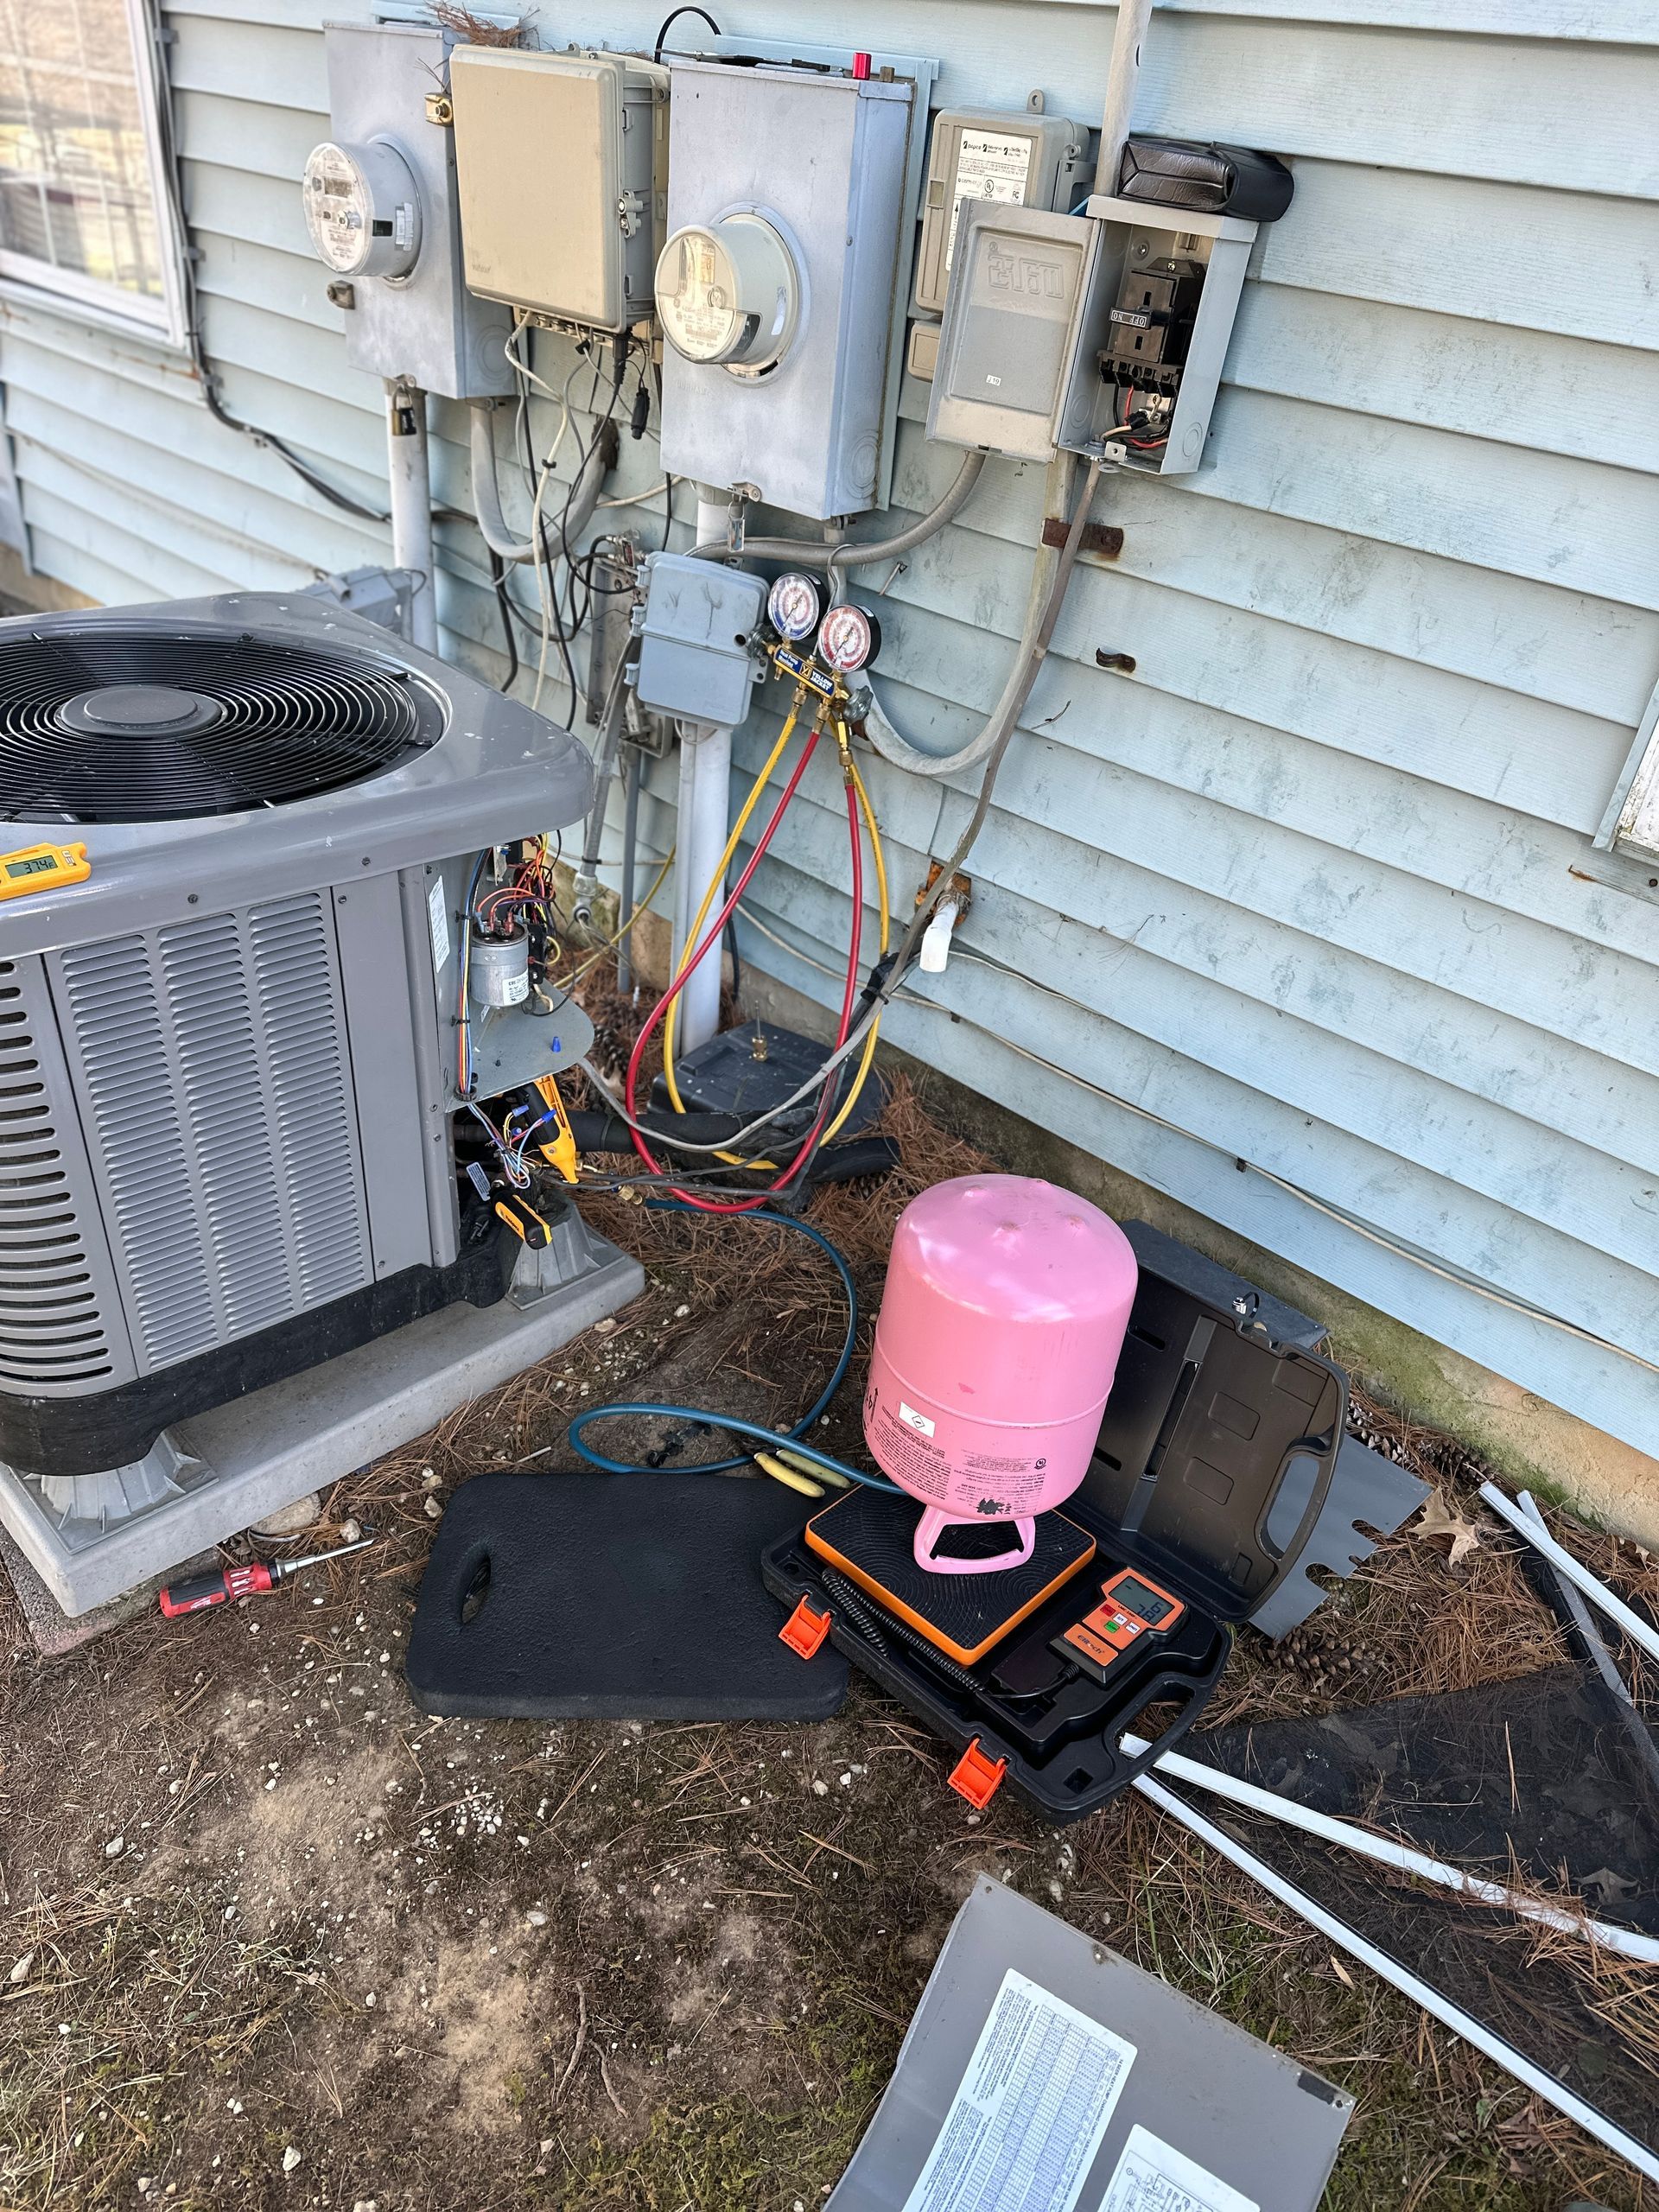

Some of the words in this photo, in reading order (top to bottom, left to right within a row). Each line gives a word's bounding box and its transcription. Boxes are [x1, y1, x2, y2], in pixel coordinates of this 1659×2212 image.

[1113, 312, 1123, 321] ON
[1129, 315, 1145, 326] OFF
[810, 677, 831, 691] JACKET
[812, 671, 833, 688] YELLOW
[1095, 2099, 1107, 2121] CHARGING
